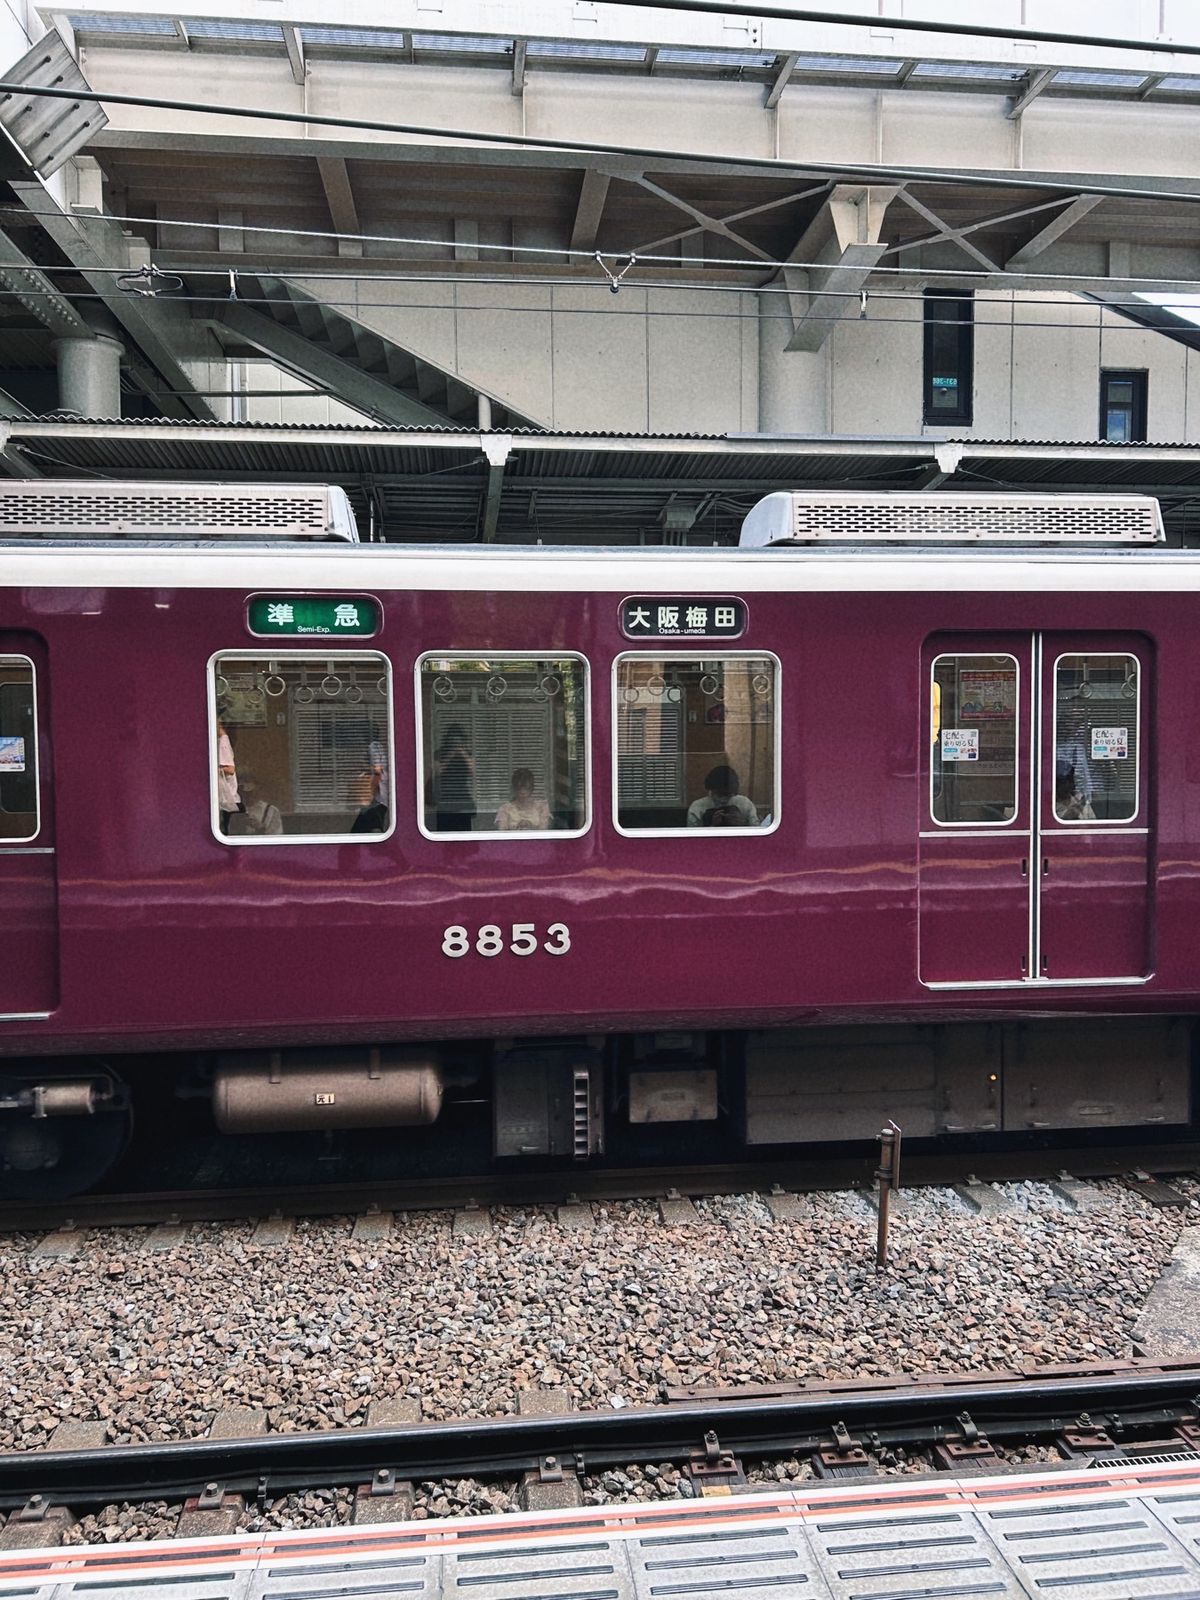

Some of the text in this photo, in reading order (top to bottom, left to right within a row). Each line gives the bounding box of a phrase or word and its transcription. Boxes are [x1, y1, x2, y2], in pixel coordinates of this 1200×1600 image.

[628, 606, 735, 628] 大阪梅田
[441, 922, 571, 958] 8853
